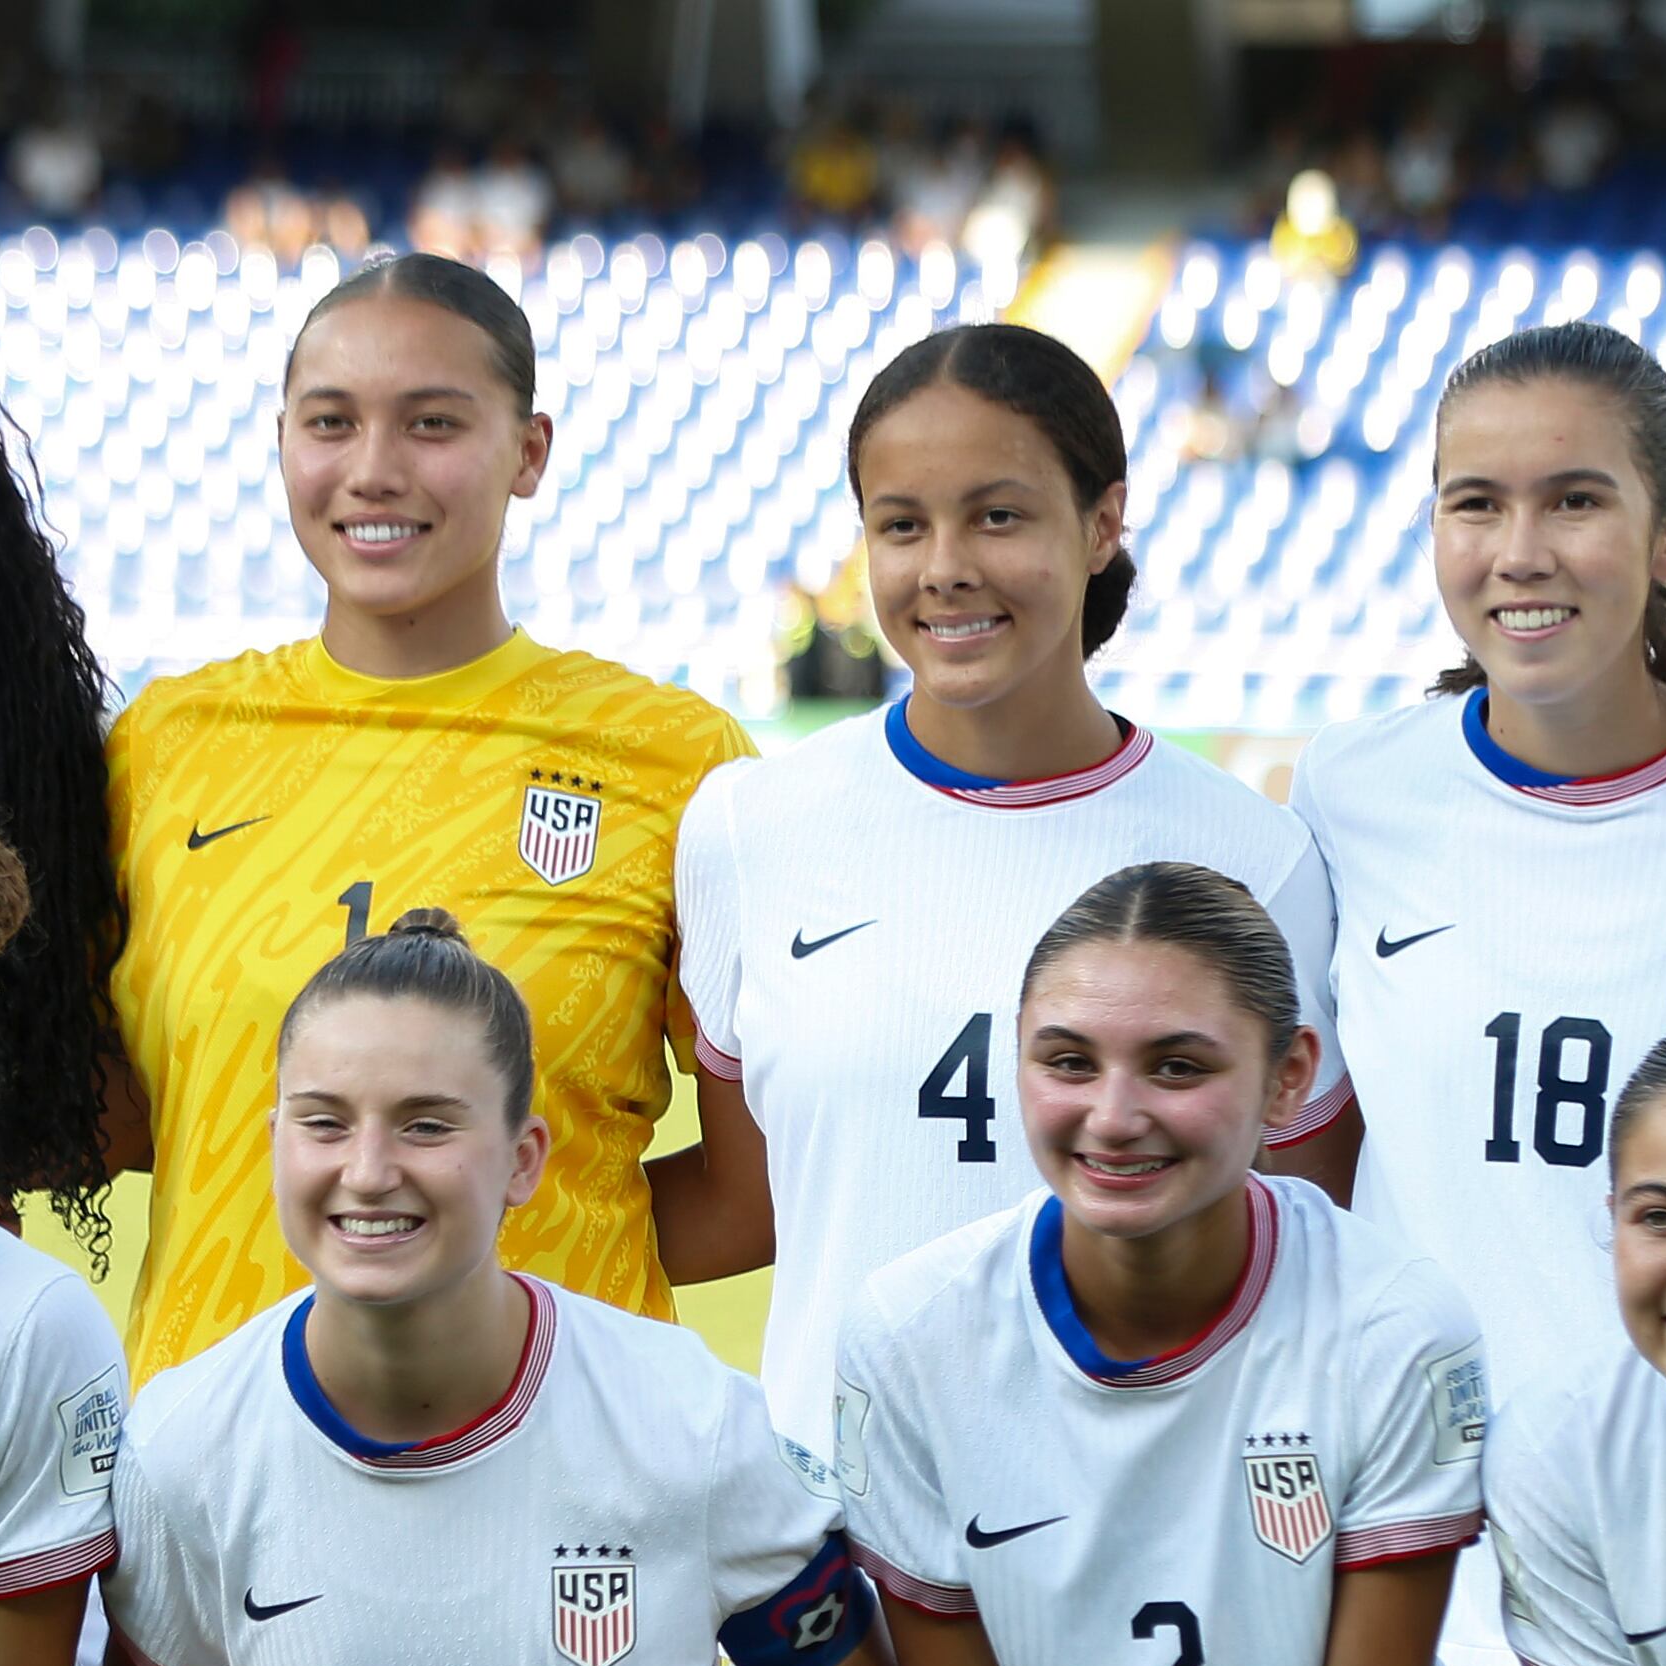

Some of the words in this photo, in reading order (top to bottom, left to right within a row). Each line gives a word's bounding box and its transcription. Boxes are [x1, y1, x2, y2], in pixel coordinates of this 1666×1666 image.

[530, 794, 594, 831] USA
[918, 1013, 997, 1163] 4
[1484, 1012, 1612, 1168] 18
[1251, 1460, 1315, 1500] USA
[559, 1572, 628, 1613] USA
